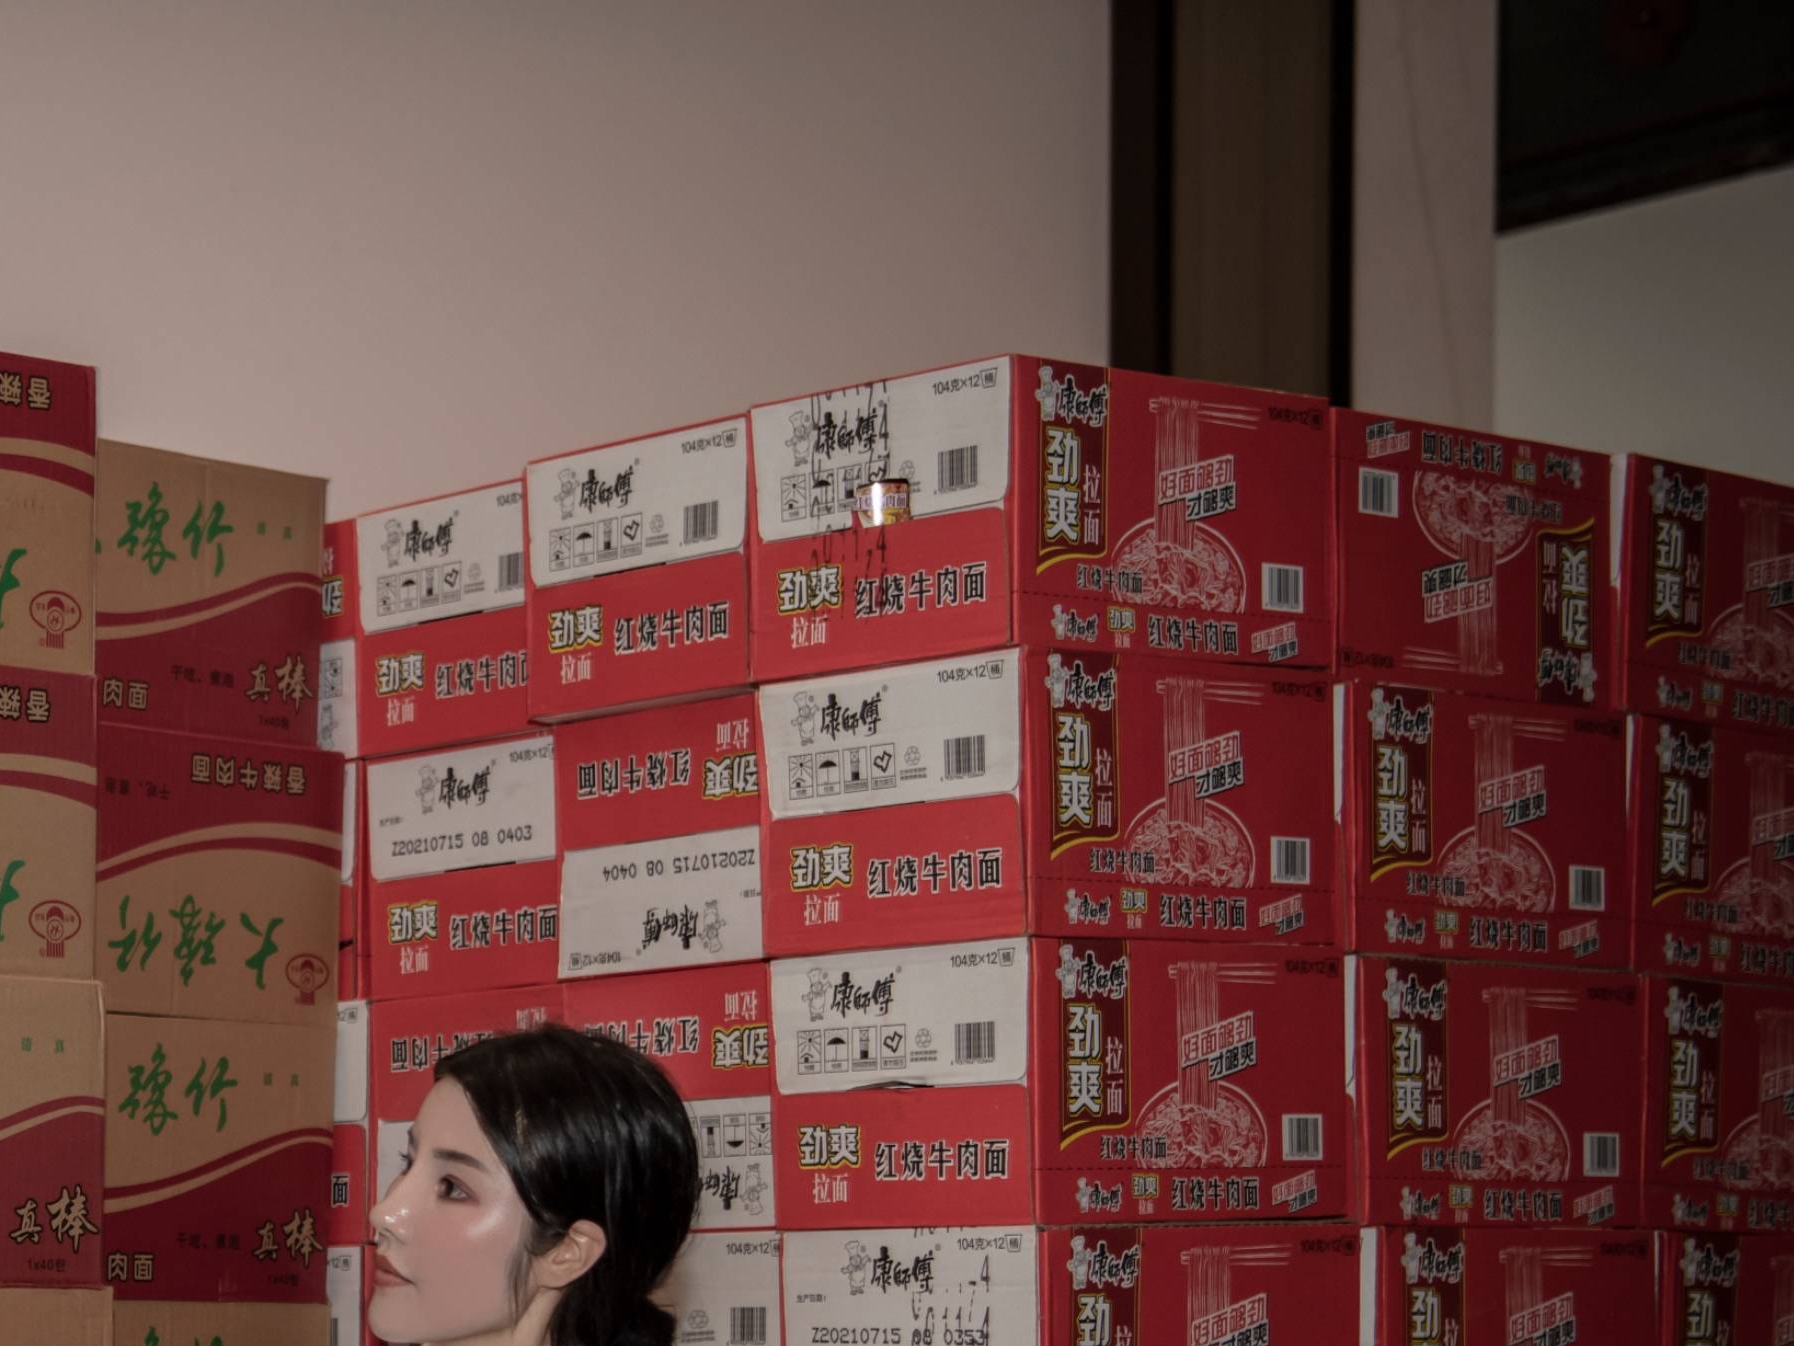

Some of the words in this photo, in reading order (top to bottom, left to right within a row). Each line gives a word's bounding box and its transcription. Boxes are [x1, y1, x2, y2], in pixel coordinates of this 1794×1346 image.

[1044, 428, 1081, 544] 劲爽
[1082, 464, 1102, 547] 拉面
[777, 566, 843, 614] 劲爽
[854, 561, 987, 619] 红烧牛肉面
[548, 604, 604, 653] 劲爽
[614, 601, 730, 656] 红烧牛肉面
[790, 615, 828, 649] 拉面
[1148, 616, 1239, 656] 红烧牛肉面
[376, 652, 425, 697] 劲爽
[560, 654, 593, 684] 拉面
[191, 753, 305, 795] 香辣牛肉面
[576, 748, 692, 800] 红烧牛肉面
[1057, 714, 1092, 827] 劲爽
[1376, 745, 1408, 853] 劲爽
[391, 833, 464, 857] Z20210715
[471, 831, 490, 848] 08
[497, 825, 533, 846] 0403
[789, 844, 855, 891] 劲爽
[866, 847, 1003, 899] 红烧牛肉面
[388, 903, 439, 944] 劲爽
[449, 904, 557, 951] 红烧牛肉面
[804, 894, 840, 926] 拉面
[1160, 894, 1247, 931] 红烧牛肉面
[1067, 1004, 1102, 1118] 劲爽
[1105, 1036, 1124, 1117] 拉面
[1391, 1023, 1423, 1131] 劲爽
[798, 1125, 862, 1170] 劲爽
[874, 1138, 1010, 1181] 红烧牛肉面
[1170, 1175, 1260, 1212] 红烧牛肉面
[9, 1184, 100, 1254] 真棒
[811, 1327, 902, 1345] Z20210715
